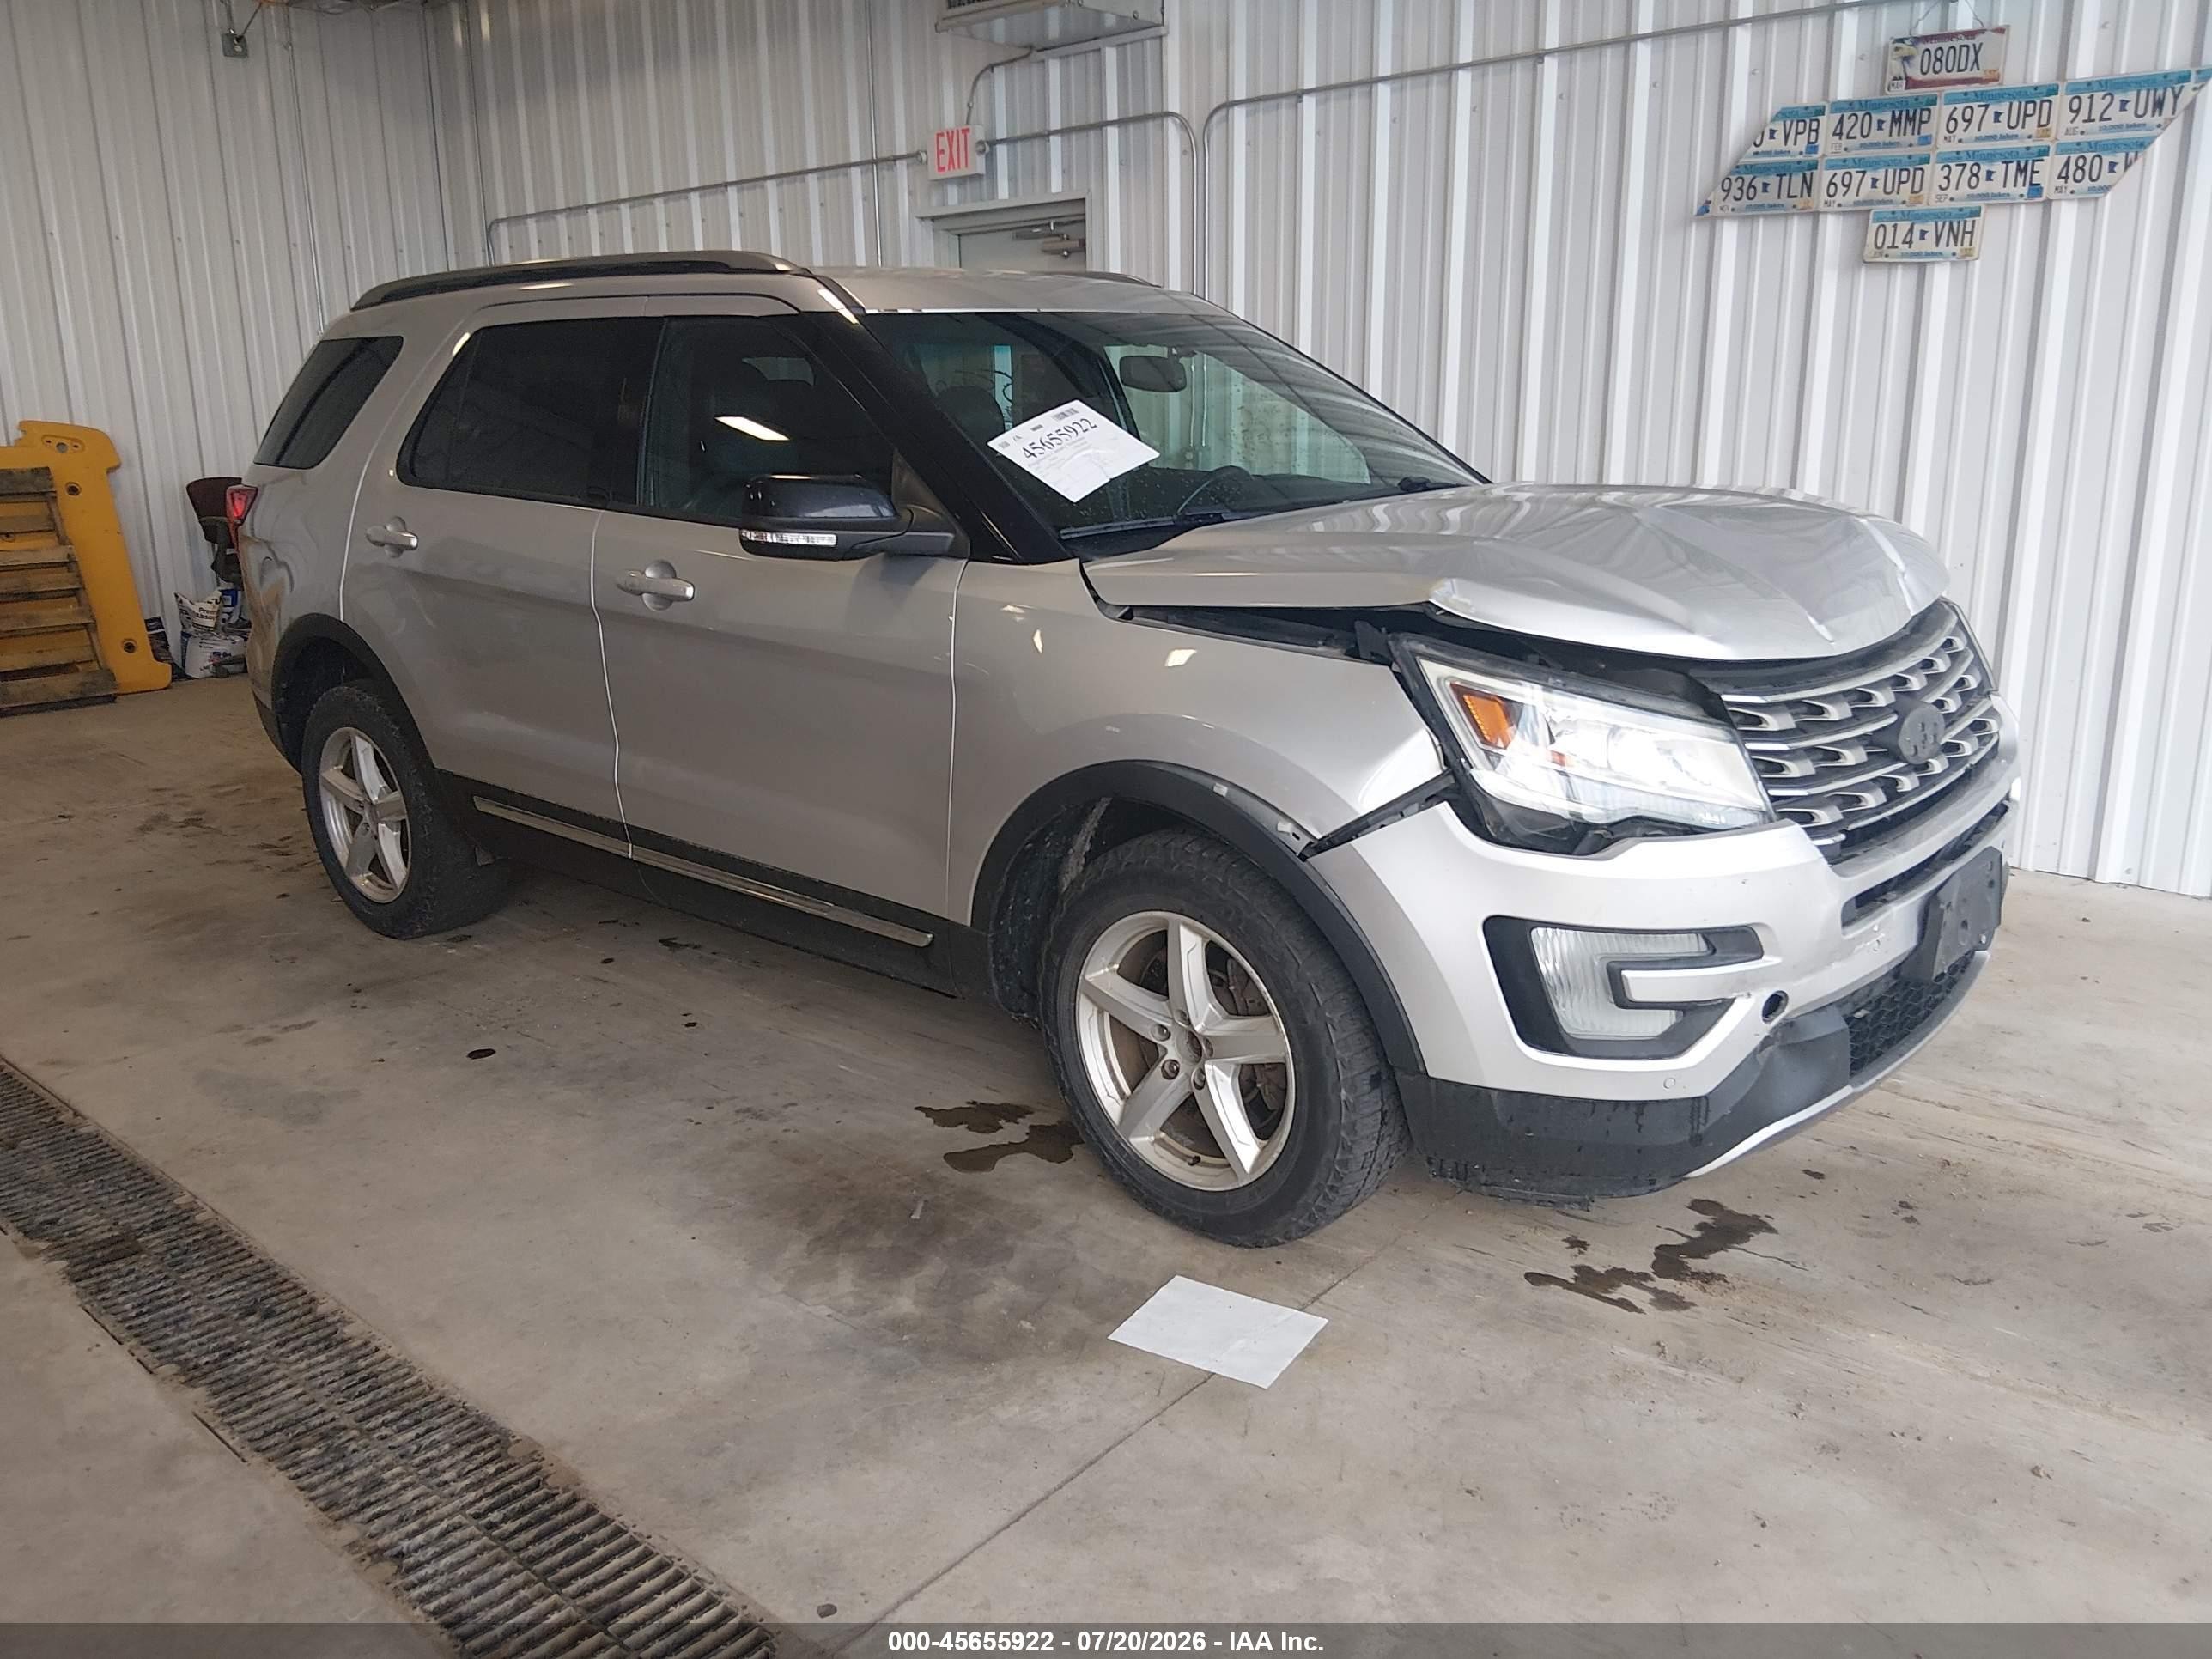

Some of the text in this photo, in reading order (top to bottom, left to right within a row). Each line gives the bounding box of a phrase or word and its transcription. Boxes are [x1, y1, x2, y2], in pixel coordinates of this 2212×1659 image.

[1973, 88, 2028, 101] Minnesota
[2069, 85, 2185, 124] 912 UWY
[1783, 118, 1820, 146] VPB
[1832, 107, 1932, 140] 420 MMP
[1945, 99, 2053, 134] 697 UPD
[935, 126, 970, 173] EXIT
[1966, 149, 2020, 161] Minnesota
[1826, 167, 1925, 198] 697 UPD
[1938, 159, 2045, 191] 378 TME
[2057, 154, 2103, 184] 480
[1721, 172, 1814, 202] 936 TLN
[1873, 218, 1977, 250] 014 VNH
[1022, 418, 1098, 459] 45655922
